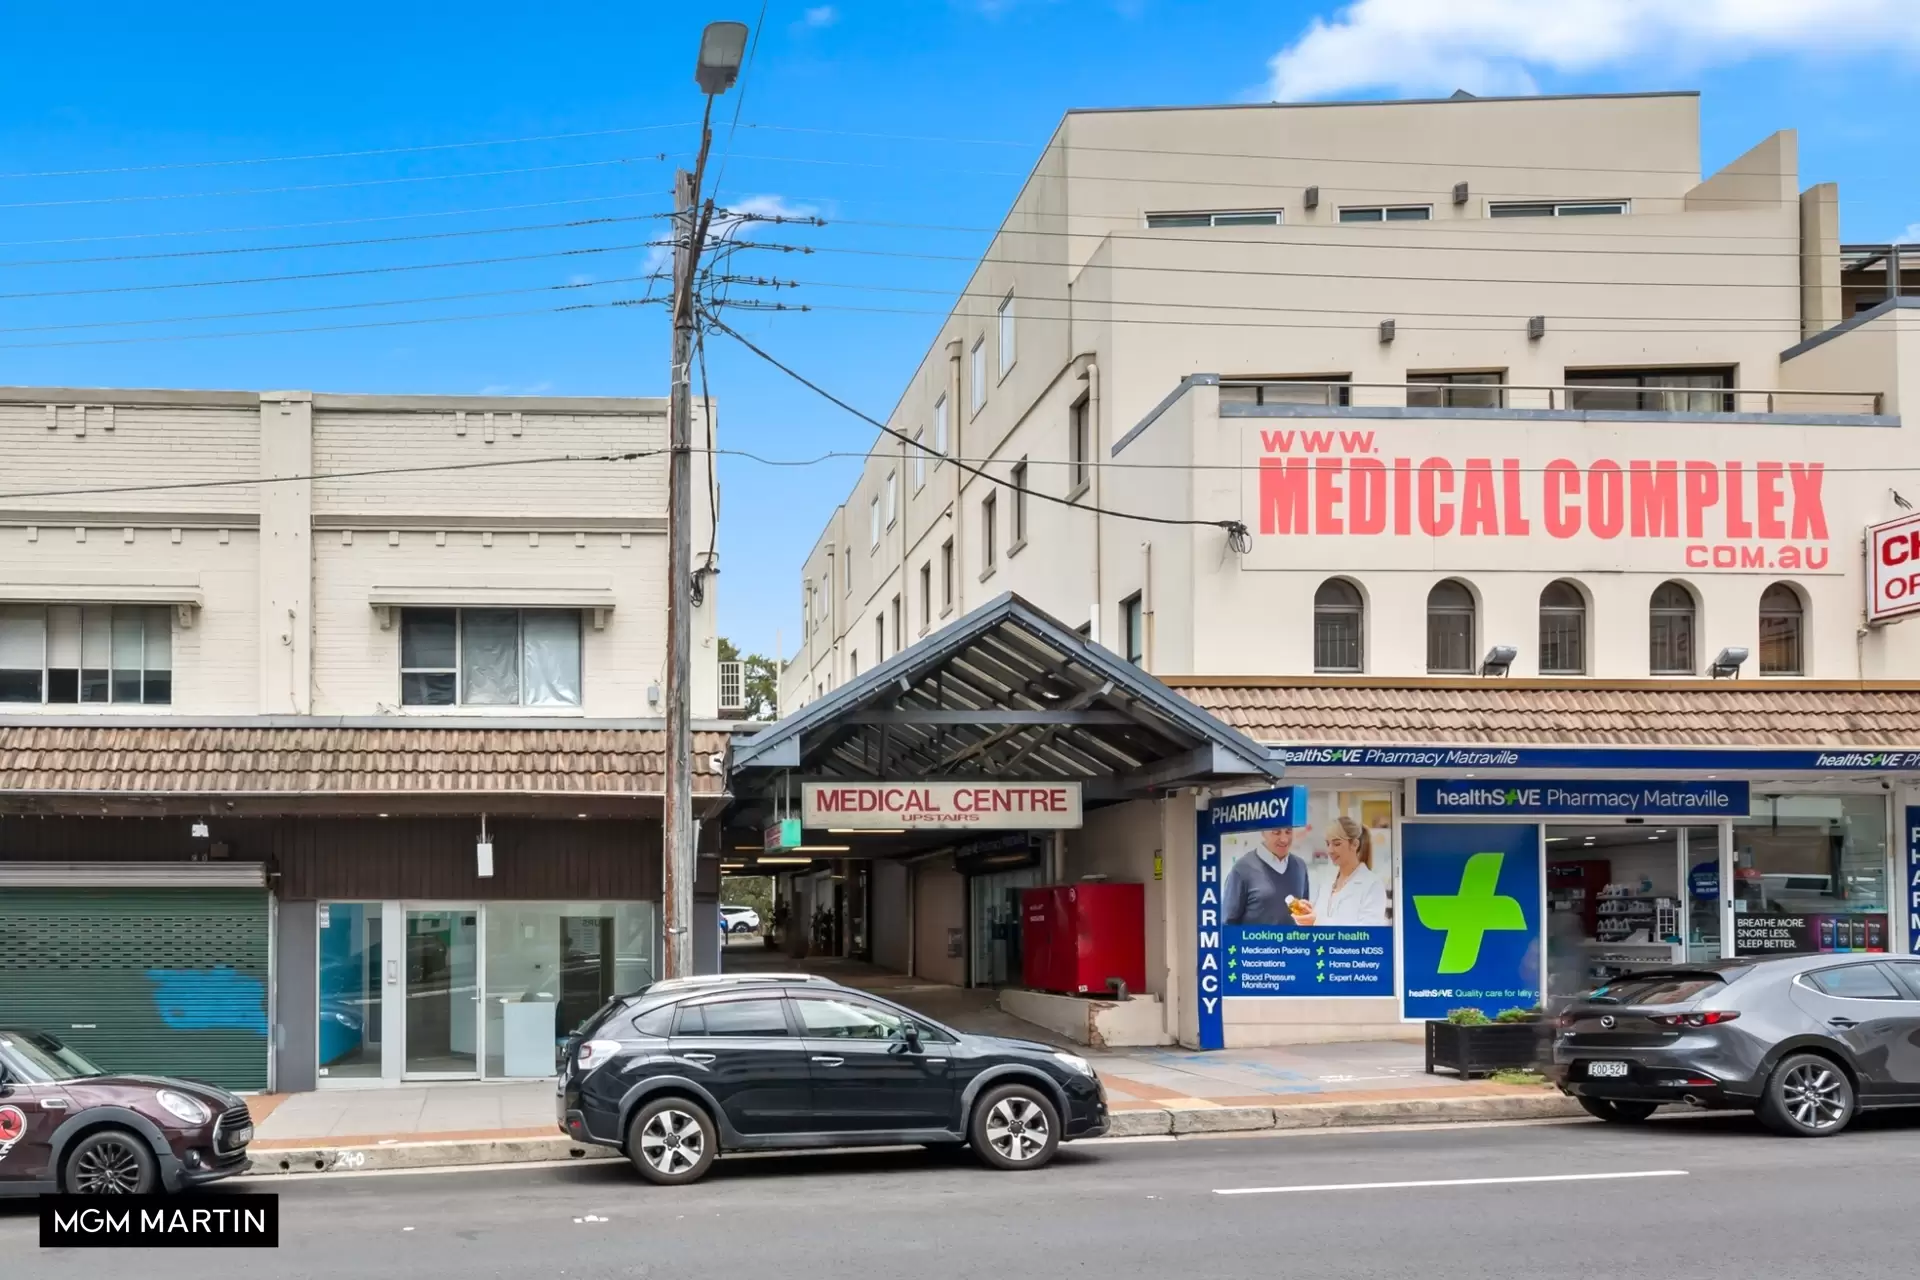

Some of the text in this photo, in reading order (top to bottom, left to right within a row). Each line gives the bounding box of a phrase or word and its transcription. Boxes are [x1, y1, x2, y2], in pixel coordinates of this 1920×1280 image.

[1259, 457, 1829, 540] MEDICAL COMPLEX
[1365, 750, 1443, 767] Pharmacy
[1445, 751, 1518, 764] Matraville
[817, 789, 1067, 812] MEDICAL CENTRE
[1548, 790, 1638, 809] Pharmacy
[1645, 791, 1728, 807] Matraville
[1212, 797, 1289, 825] PHARMACY
[901, 814, 980, 822] UPSTAIRS
[1737, 919, 1806, 927] BREATHE MORE.
[1200, 844, 1219, 1014] PHARMACY
[1737, 929, 1791, 938] SNORE LESS.
[1242, 931, 1369, 942] Looking after your health
[1737, 939, 1797, 948] SLEEP BETTER.
[1242, 946, 1310, 956] Medication Packing
[1329, 947, 1383, 955] Diabetes NDSS
[1352, 961, 1380, 969] Delivery
[1329, 974, 1352, 982] Expert
[1242, 982, 1279, 990] Monitoring
[1455, 989, 1483, 998] Quality
[1504, 989, 1516, 997] for
[337, 1152, 365, 1167] 240
